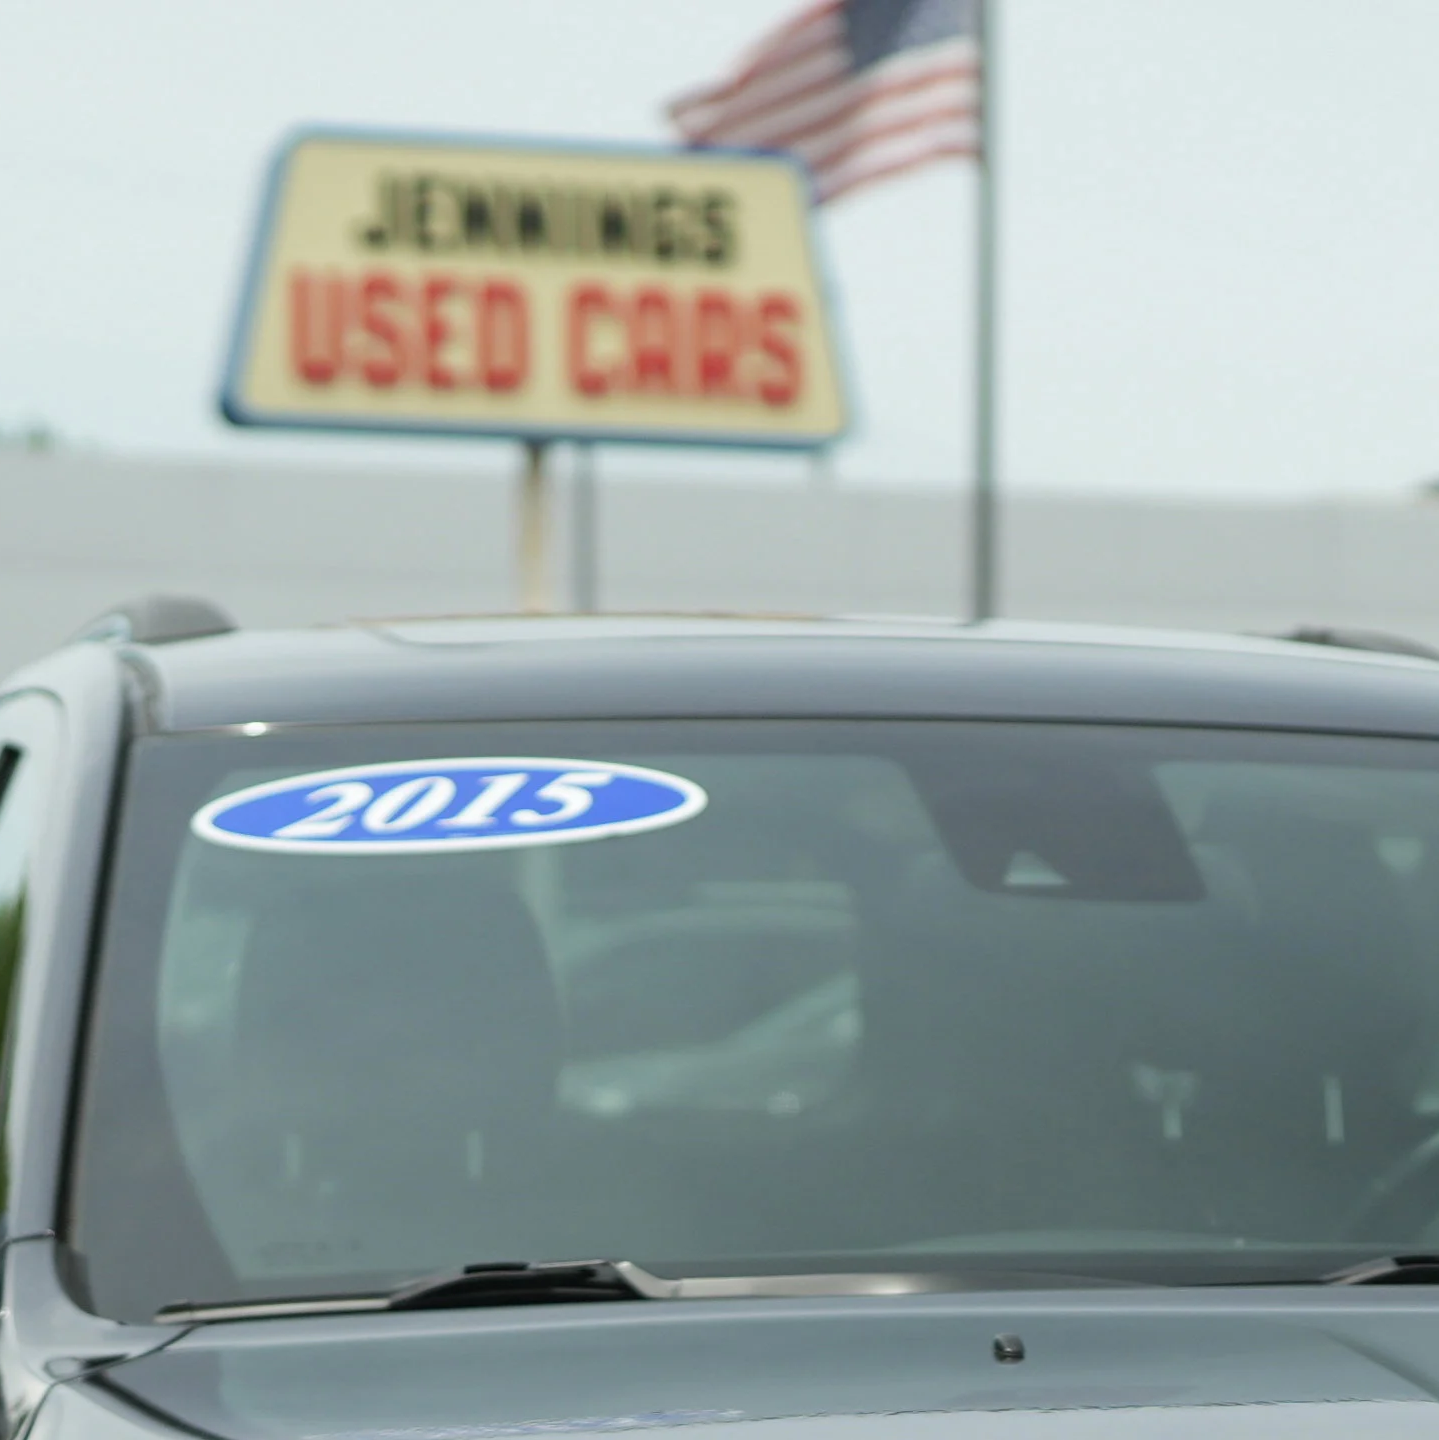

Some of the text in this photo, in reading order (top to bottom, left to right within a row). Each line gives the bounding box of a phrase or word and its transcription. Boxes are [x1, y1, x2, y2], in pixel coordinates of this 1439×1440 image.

[354, 168, 740, 266] JENNINGS
[288, 267, 805, 409] USED CARS
[272, 770, 615, 839] 2015
